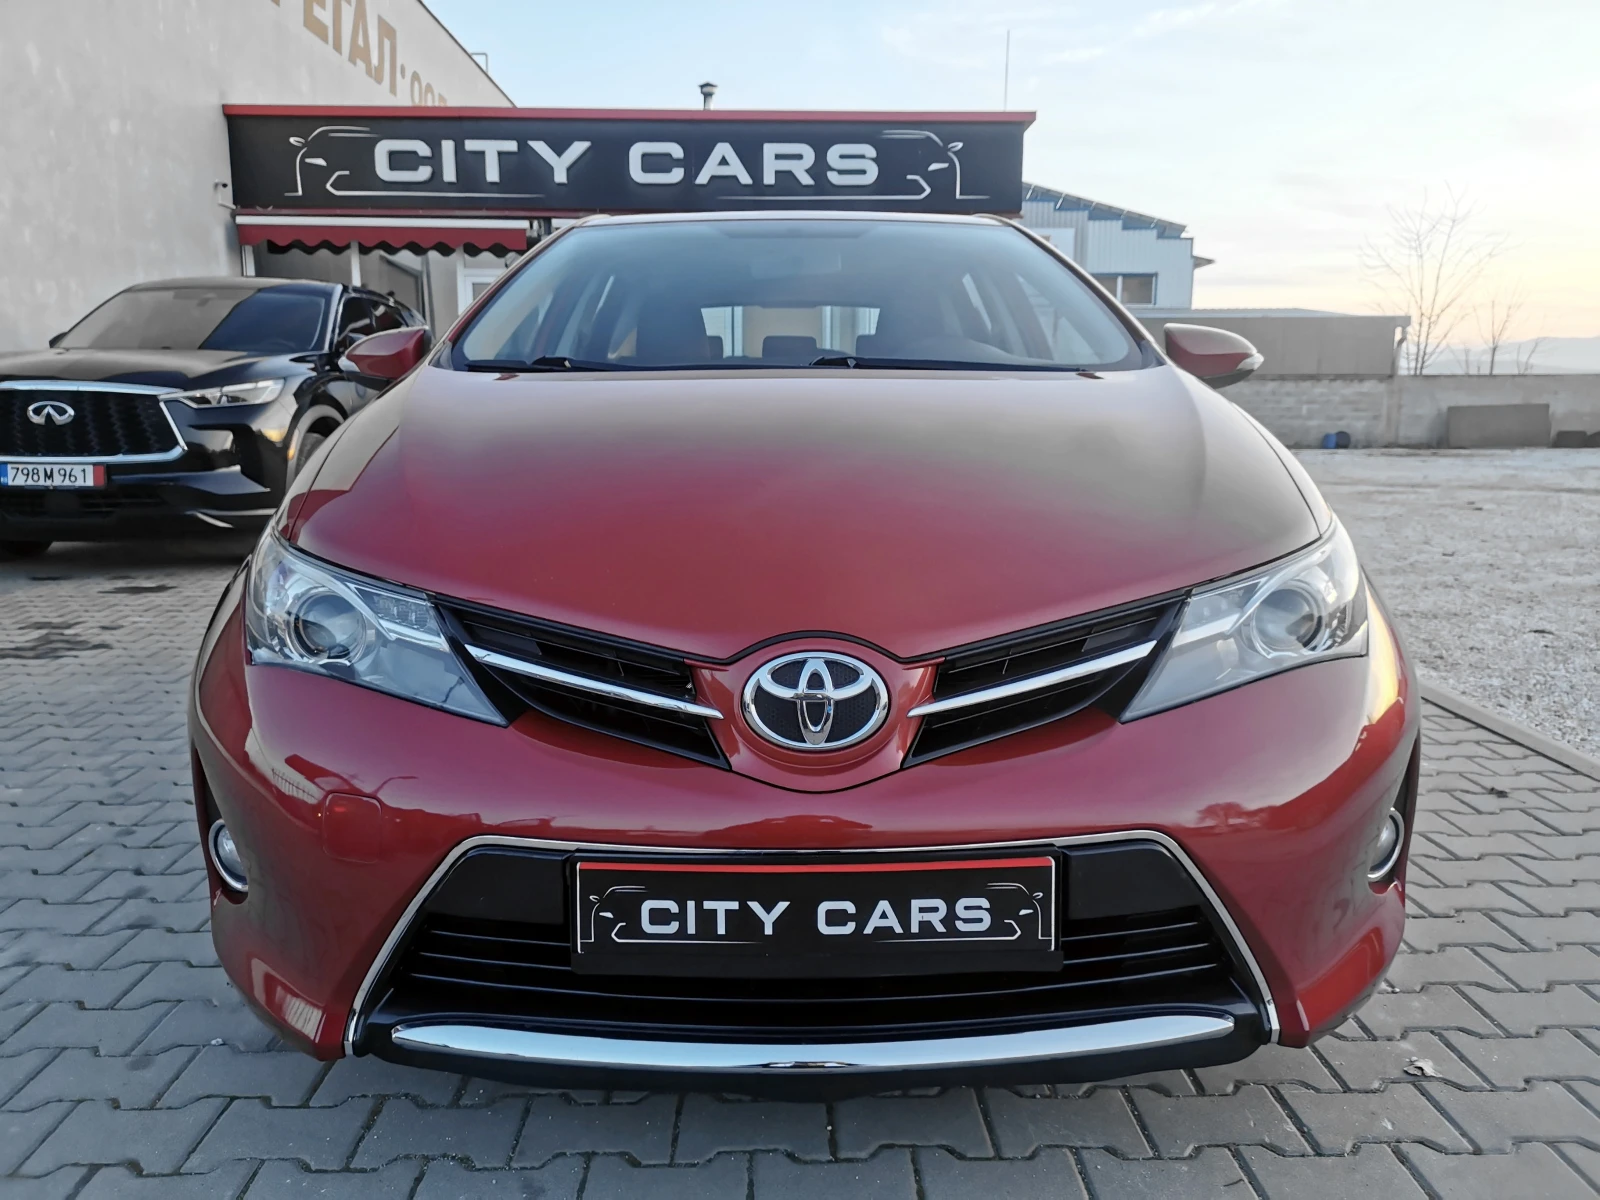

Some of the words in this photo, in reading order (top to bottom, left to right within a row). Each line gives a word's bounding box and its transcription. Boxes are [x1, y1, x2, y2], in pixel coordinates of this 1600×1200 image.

[374, 138, 592, 185] CITY
[628, 141, 880, 187] CARS
[640, 899, 791, 936] CITY
[816, 896, 992, 936] CARS
